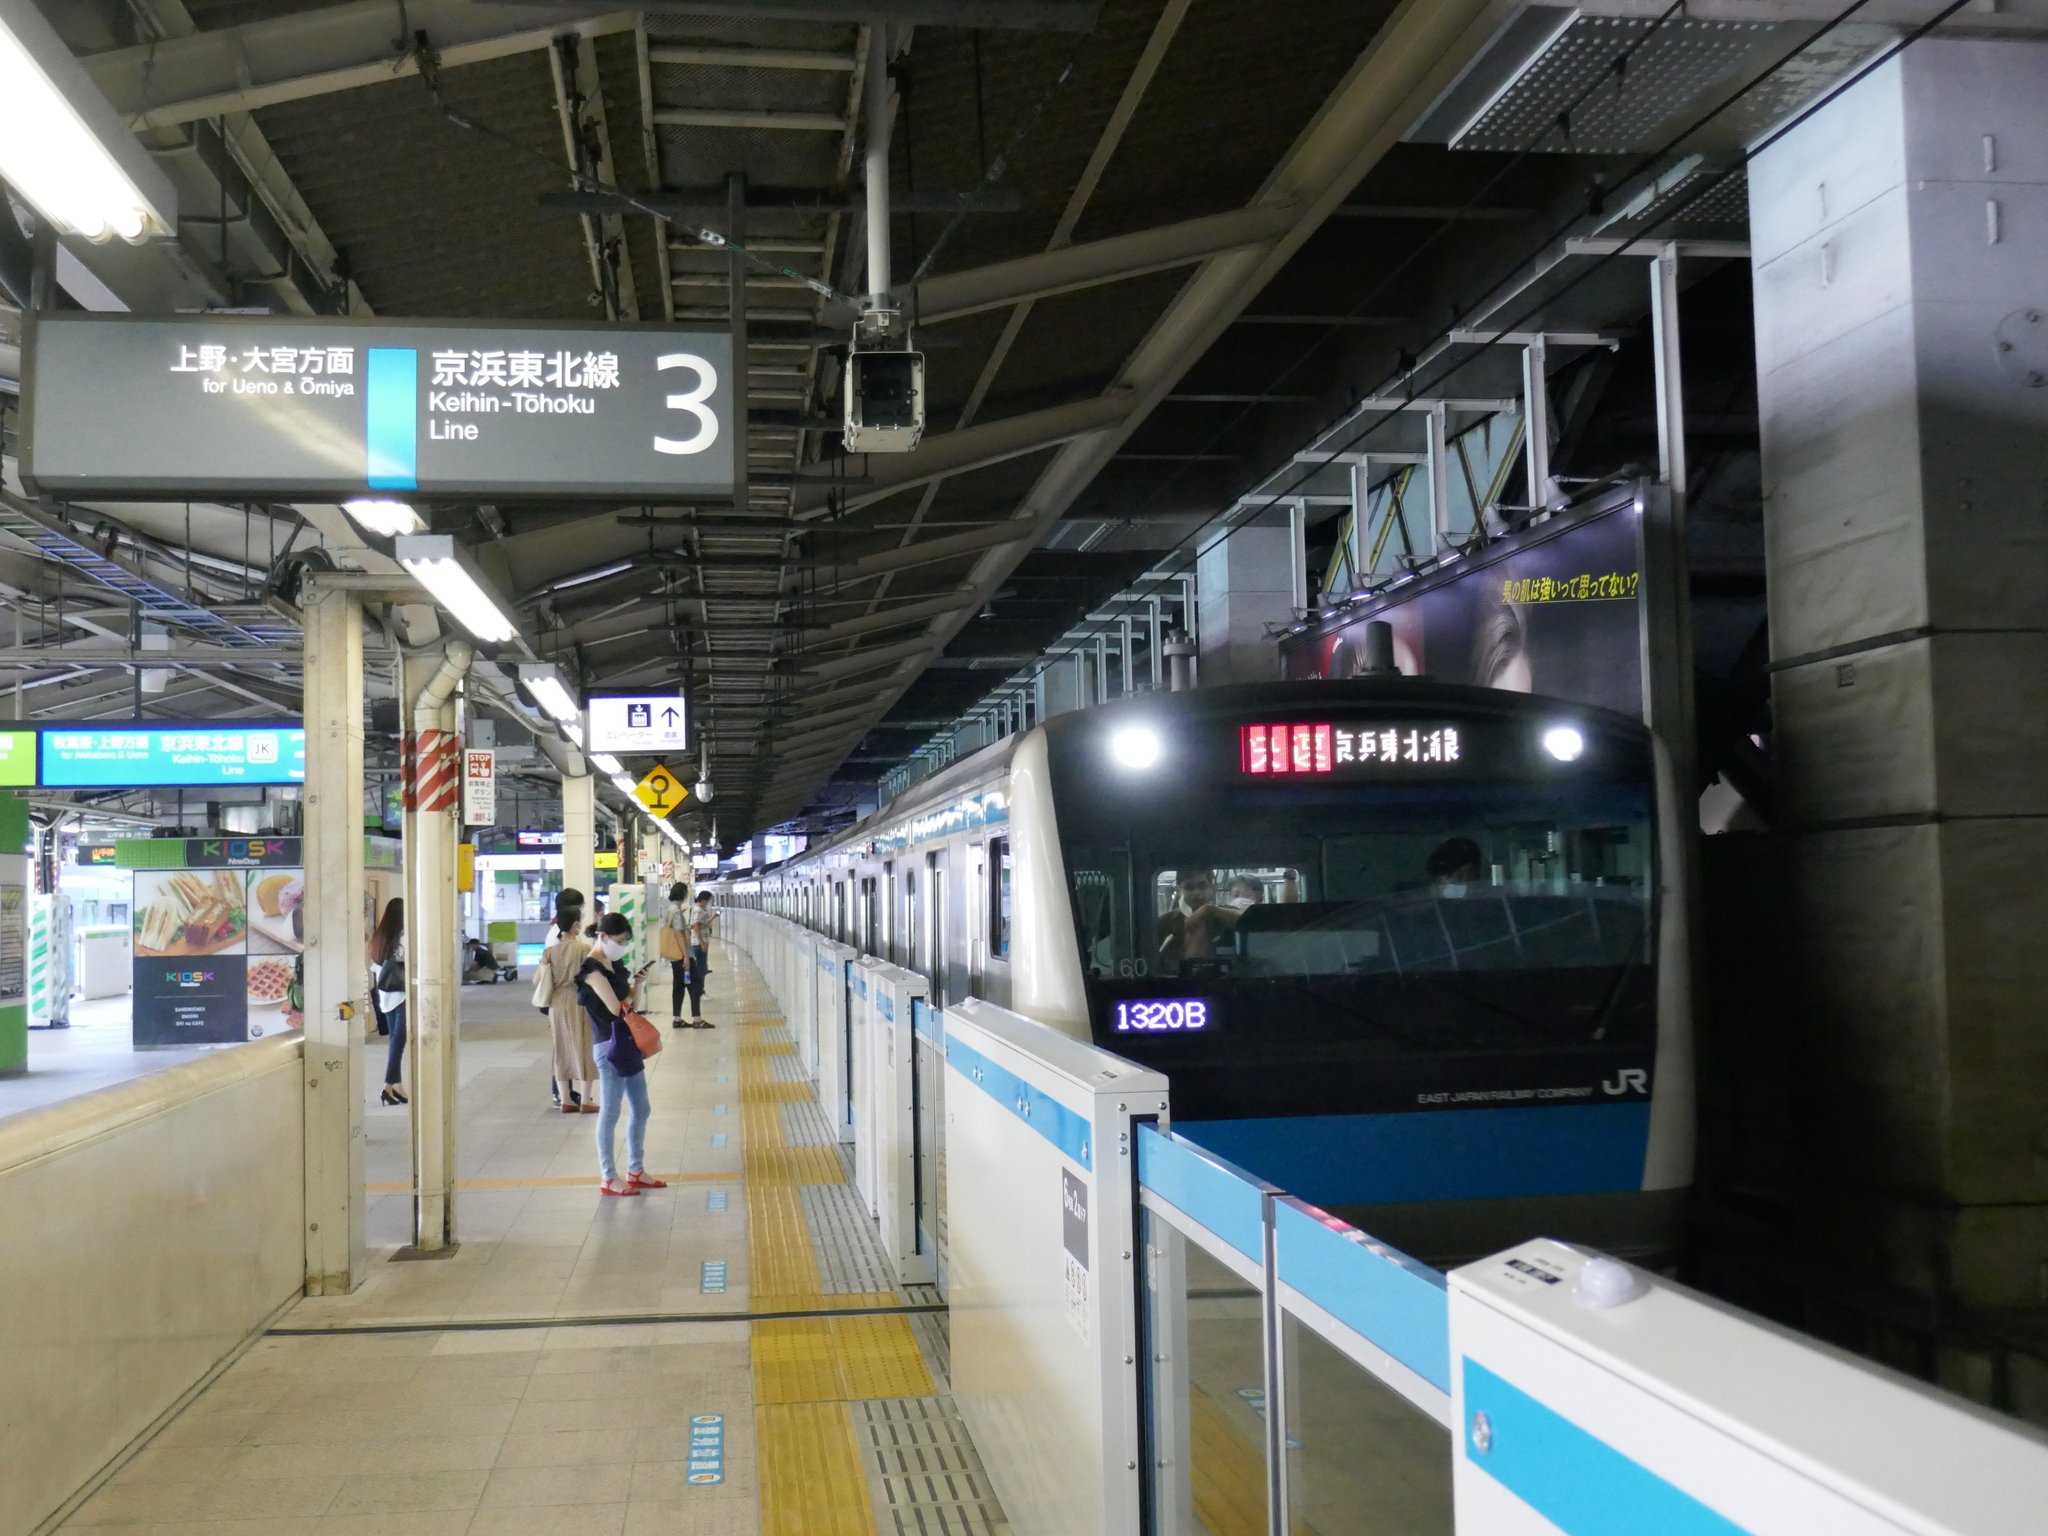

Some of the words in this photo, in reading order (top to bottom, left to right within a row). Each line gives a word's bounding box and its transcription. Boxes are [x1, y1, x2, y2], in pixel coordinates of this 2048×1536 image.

[170, 345, 355, 374] 上野・大宮方面
[431, 349, 620, 389] 京浜東北線
[203, 378, 227, 393] for
[233, 378, 278, 394] Ueno
[284, 381, 294, 394] &
[429, 391, 595, 414] Keihin-Tōhoku
[653, 353, 719, 455] 3
[429, 419, 479, 440] Line
[255, 743, 270, 755] JK
[470, 753, 491, 762] STOP
[222, 765, 245, 775] Line
[80, 832, 90, 844] 4
[203, 840, 285, 857] KIOSK
[166, 971, 215, 982] KIOSK
[1117, 1001, 1207, 1030] 1320B
[1602, 1068, 1648, 1095] JR
[1417, 1092, 1450, 1104] EAST
[1451, 1090, 1490, 1102] JAPAN
